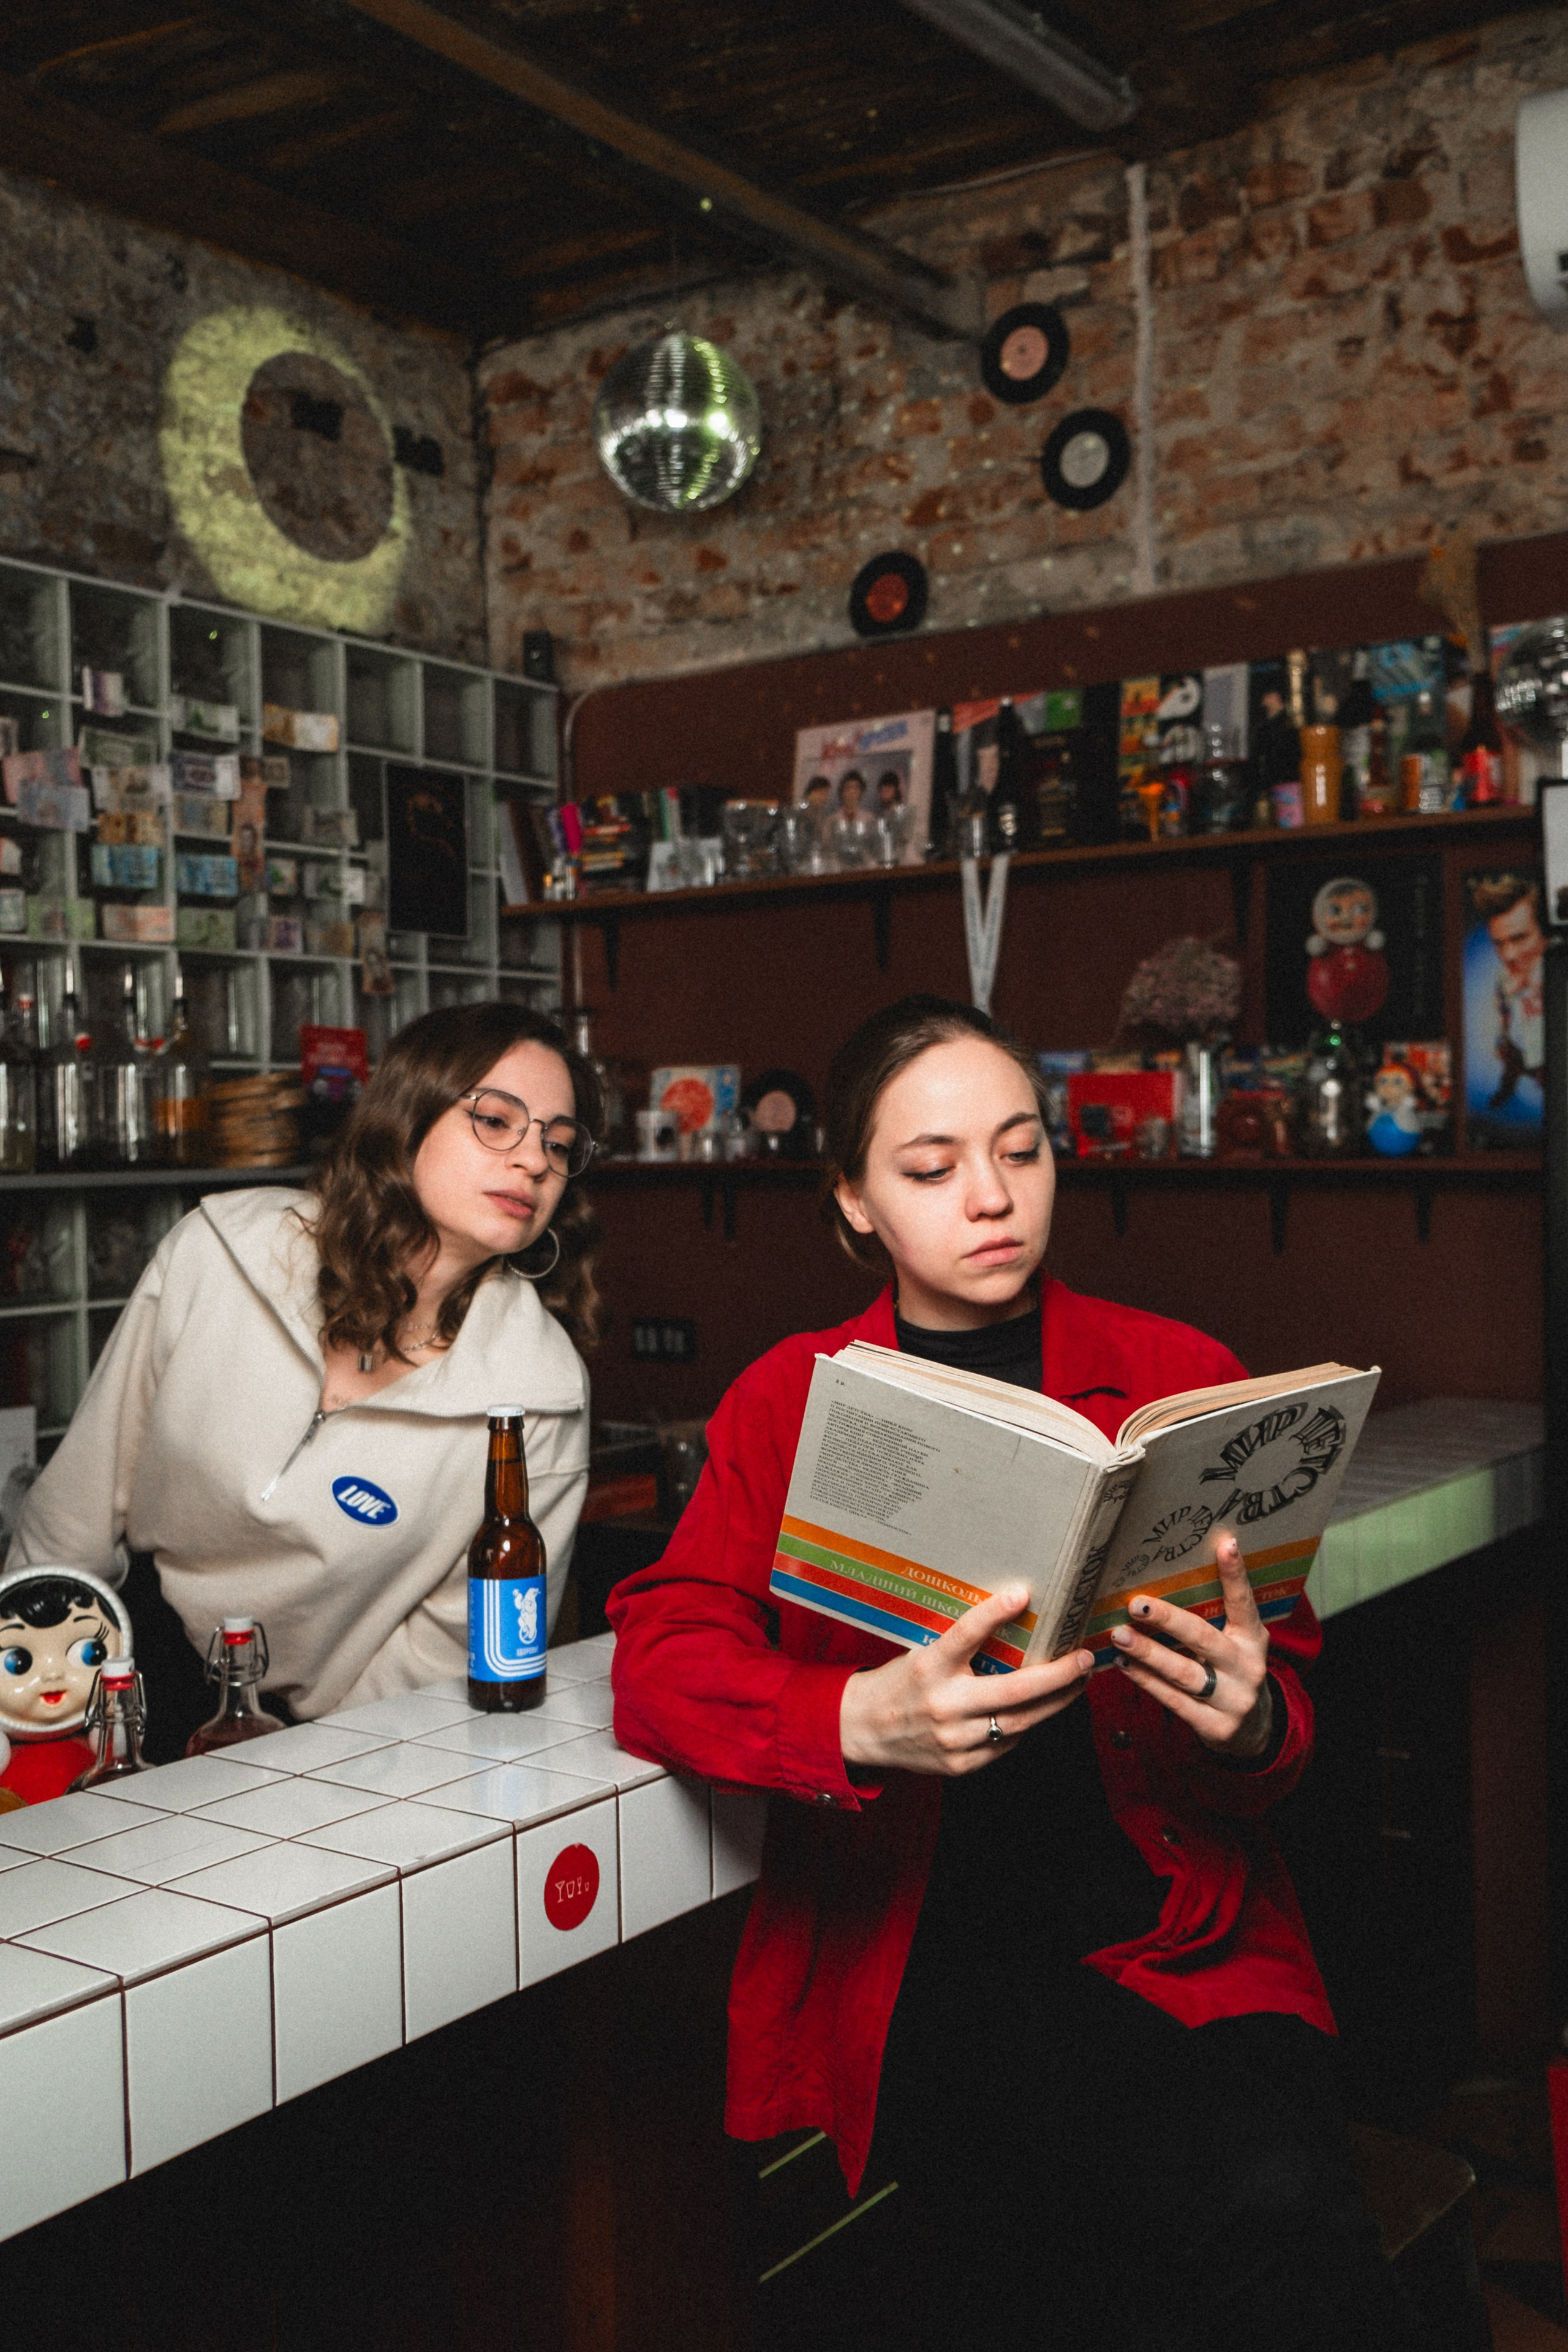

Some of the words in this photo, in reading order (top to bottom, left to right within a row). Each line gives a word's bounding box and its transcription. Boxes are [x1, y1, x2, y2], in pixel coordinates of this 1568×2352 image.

[337, 1484, 391, 1519] LOVE
[830, 1559, 918, 1600] МЛАДШИЙ
[900, 1566, 984, 1605] ДОШКОЛЬ
